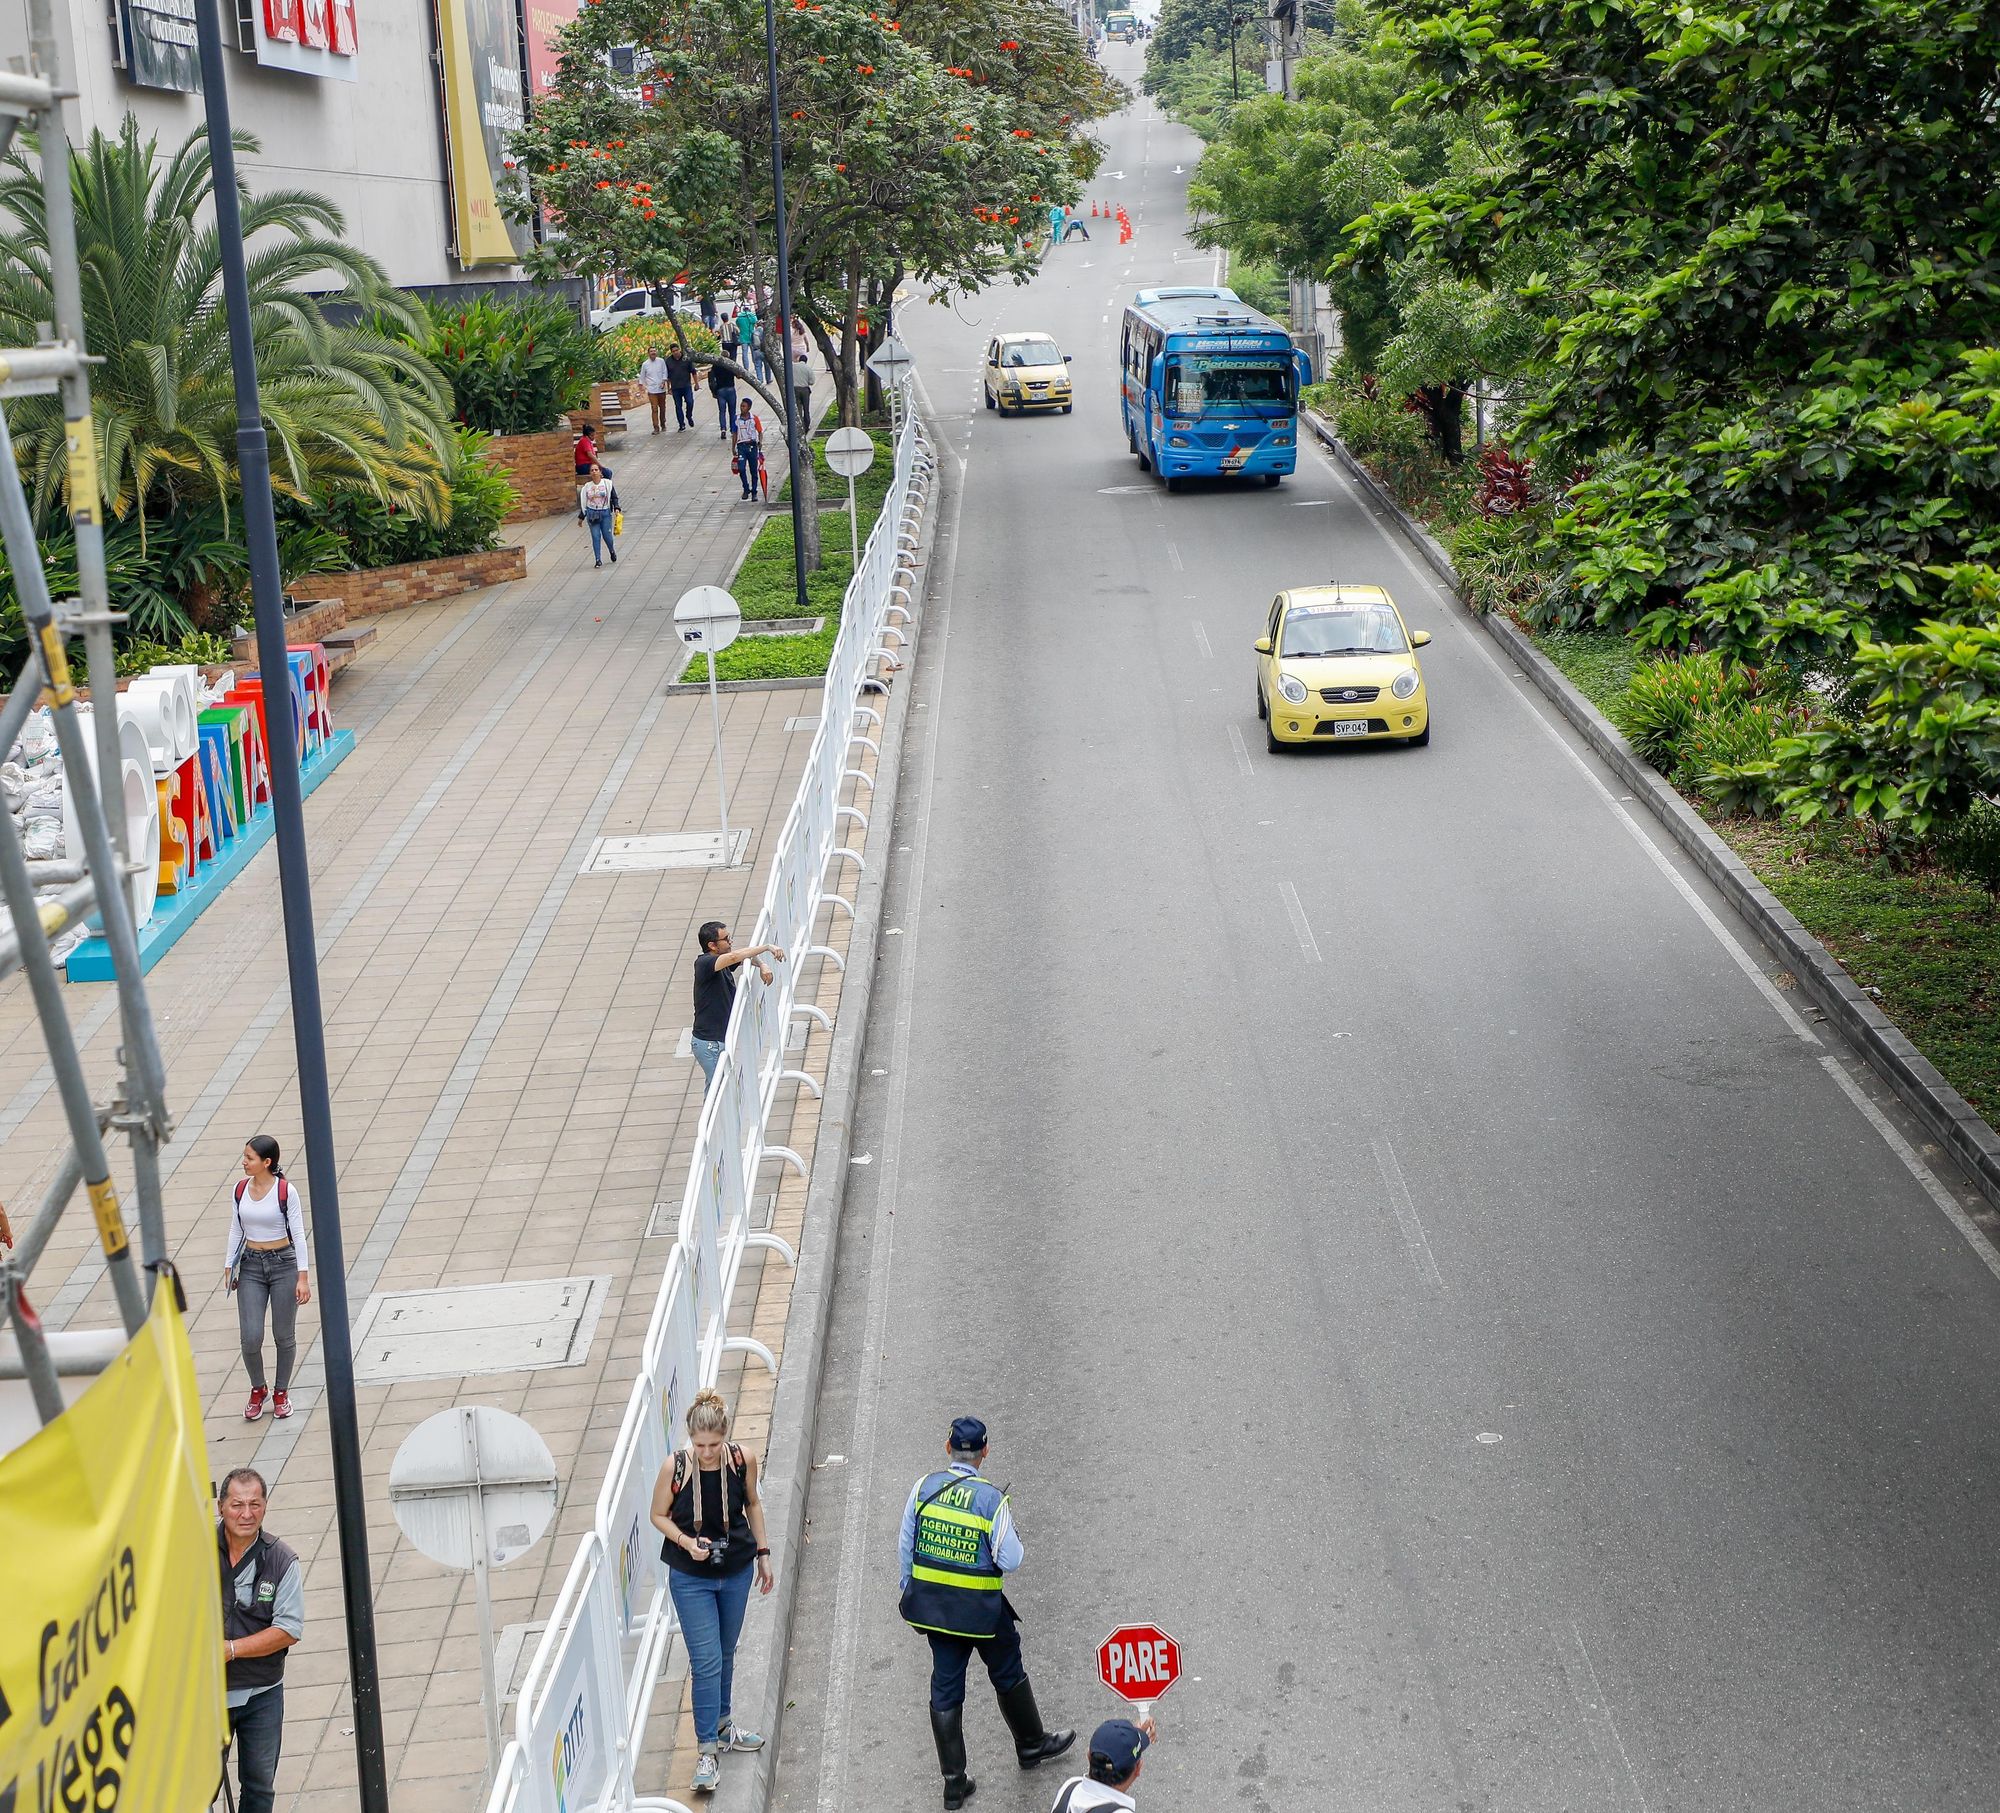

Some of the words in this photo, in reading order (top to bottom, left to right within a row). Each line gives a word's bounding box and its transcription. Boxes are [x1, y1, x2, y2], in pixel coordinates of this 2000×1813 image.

[487, 55, 519, 93] Vivamos
[1198, 360, 1281, 369] Piedecuesta
[921, 1518, 962, 1536] AGENTE
[965, 1530, 979, 1539] DE
[921, 1530, 977, 1551] TRANSITO
[918, 1542, 975, 1563] FLORIDABLANCA
[1109, 1640, 1170, 1684] PARE
